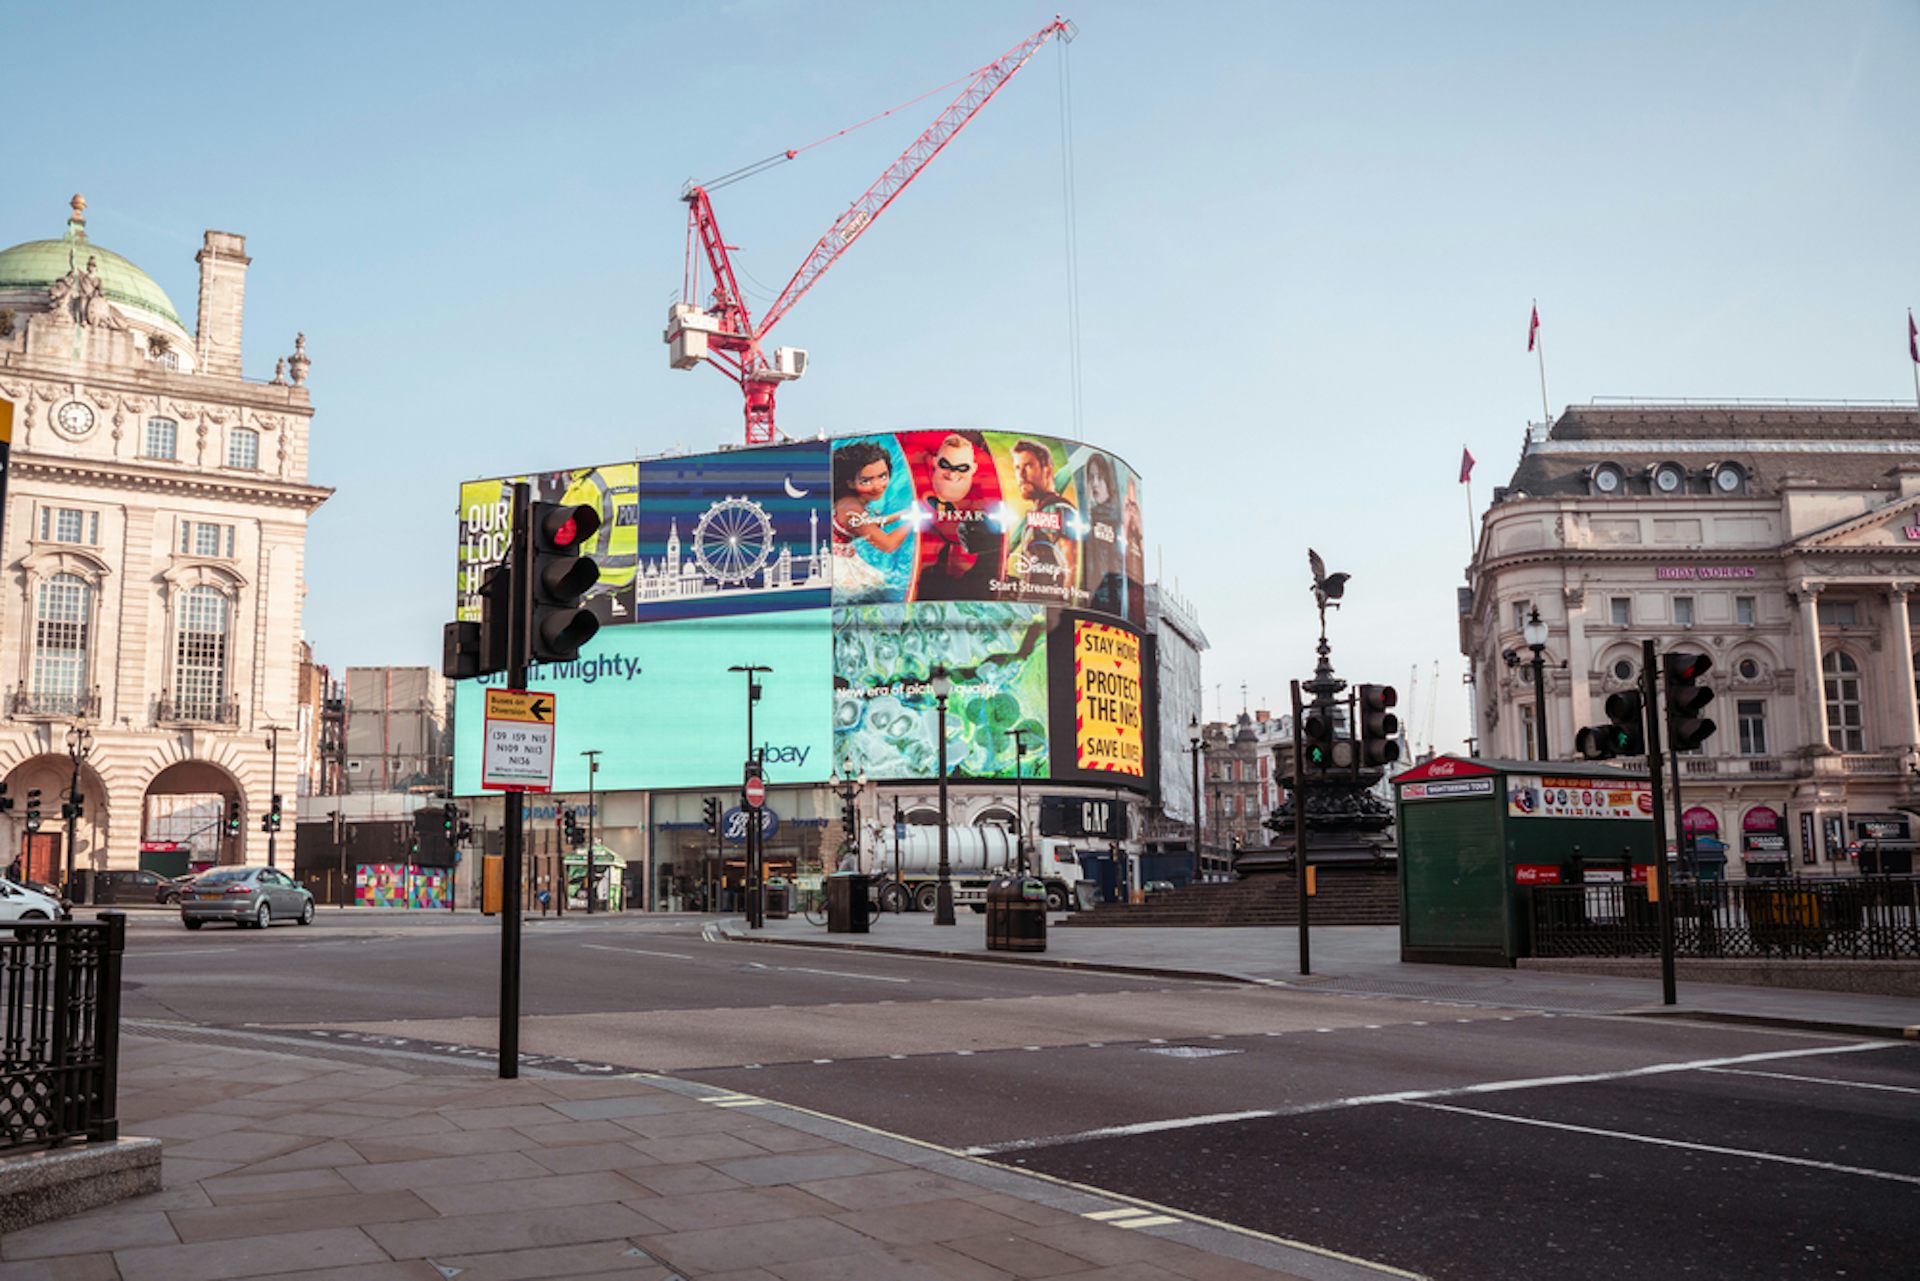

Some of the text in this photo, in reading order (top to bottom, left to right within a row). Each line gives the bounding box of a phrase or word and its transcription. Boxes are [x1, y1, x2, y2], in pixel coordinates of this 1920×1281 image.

[467, 502, 508, 534] OUR
[937, 510, 984, 522] PIXAR
[1027, 513, 1061, 530] MARVEL
[989, 579, 1090, 600] Start Streaming Now
[1085, 633, 1137, 664] STAY HOME
[553, 652, 642, 684] Mighty.
[837, 687, 863, 697] New
[866, 687, 889, 696] era
[890, 683, 905, 696] of
[956, 682, 998, 697] quality
[1087, 668, 1138, 701] PROTECT
[1087, 696, 1138, 728] THE NHS
[493, 731, 507, 740] 139
[512, 733, 526, 742] 159
[496, 744, 519, 753] N109
[1087, 737, 1139, 763] SAVE LIVES
[509, 756, 530, 765] N136
[1081, 801, 1109, 832] GAP
